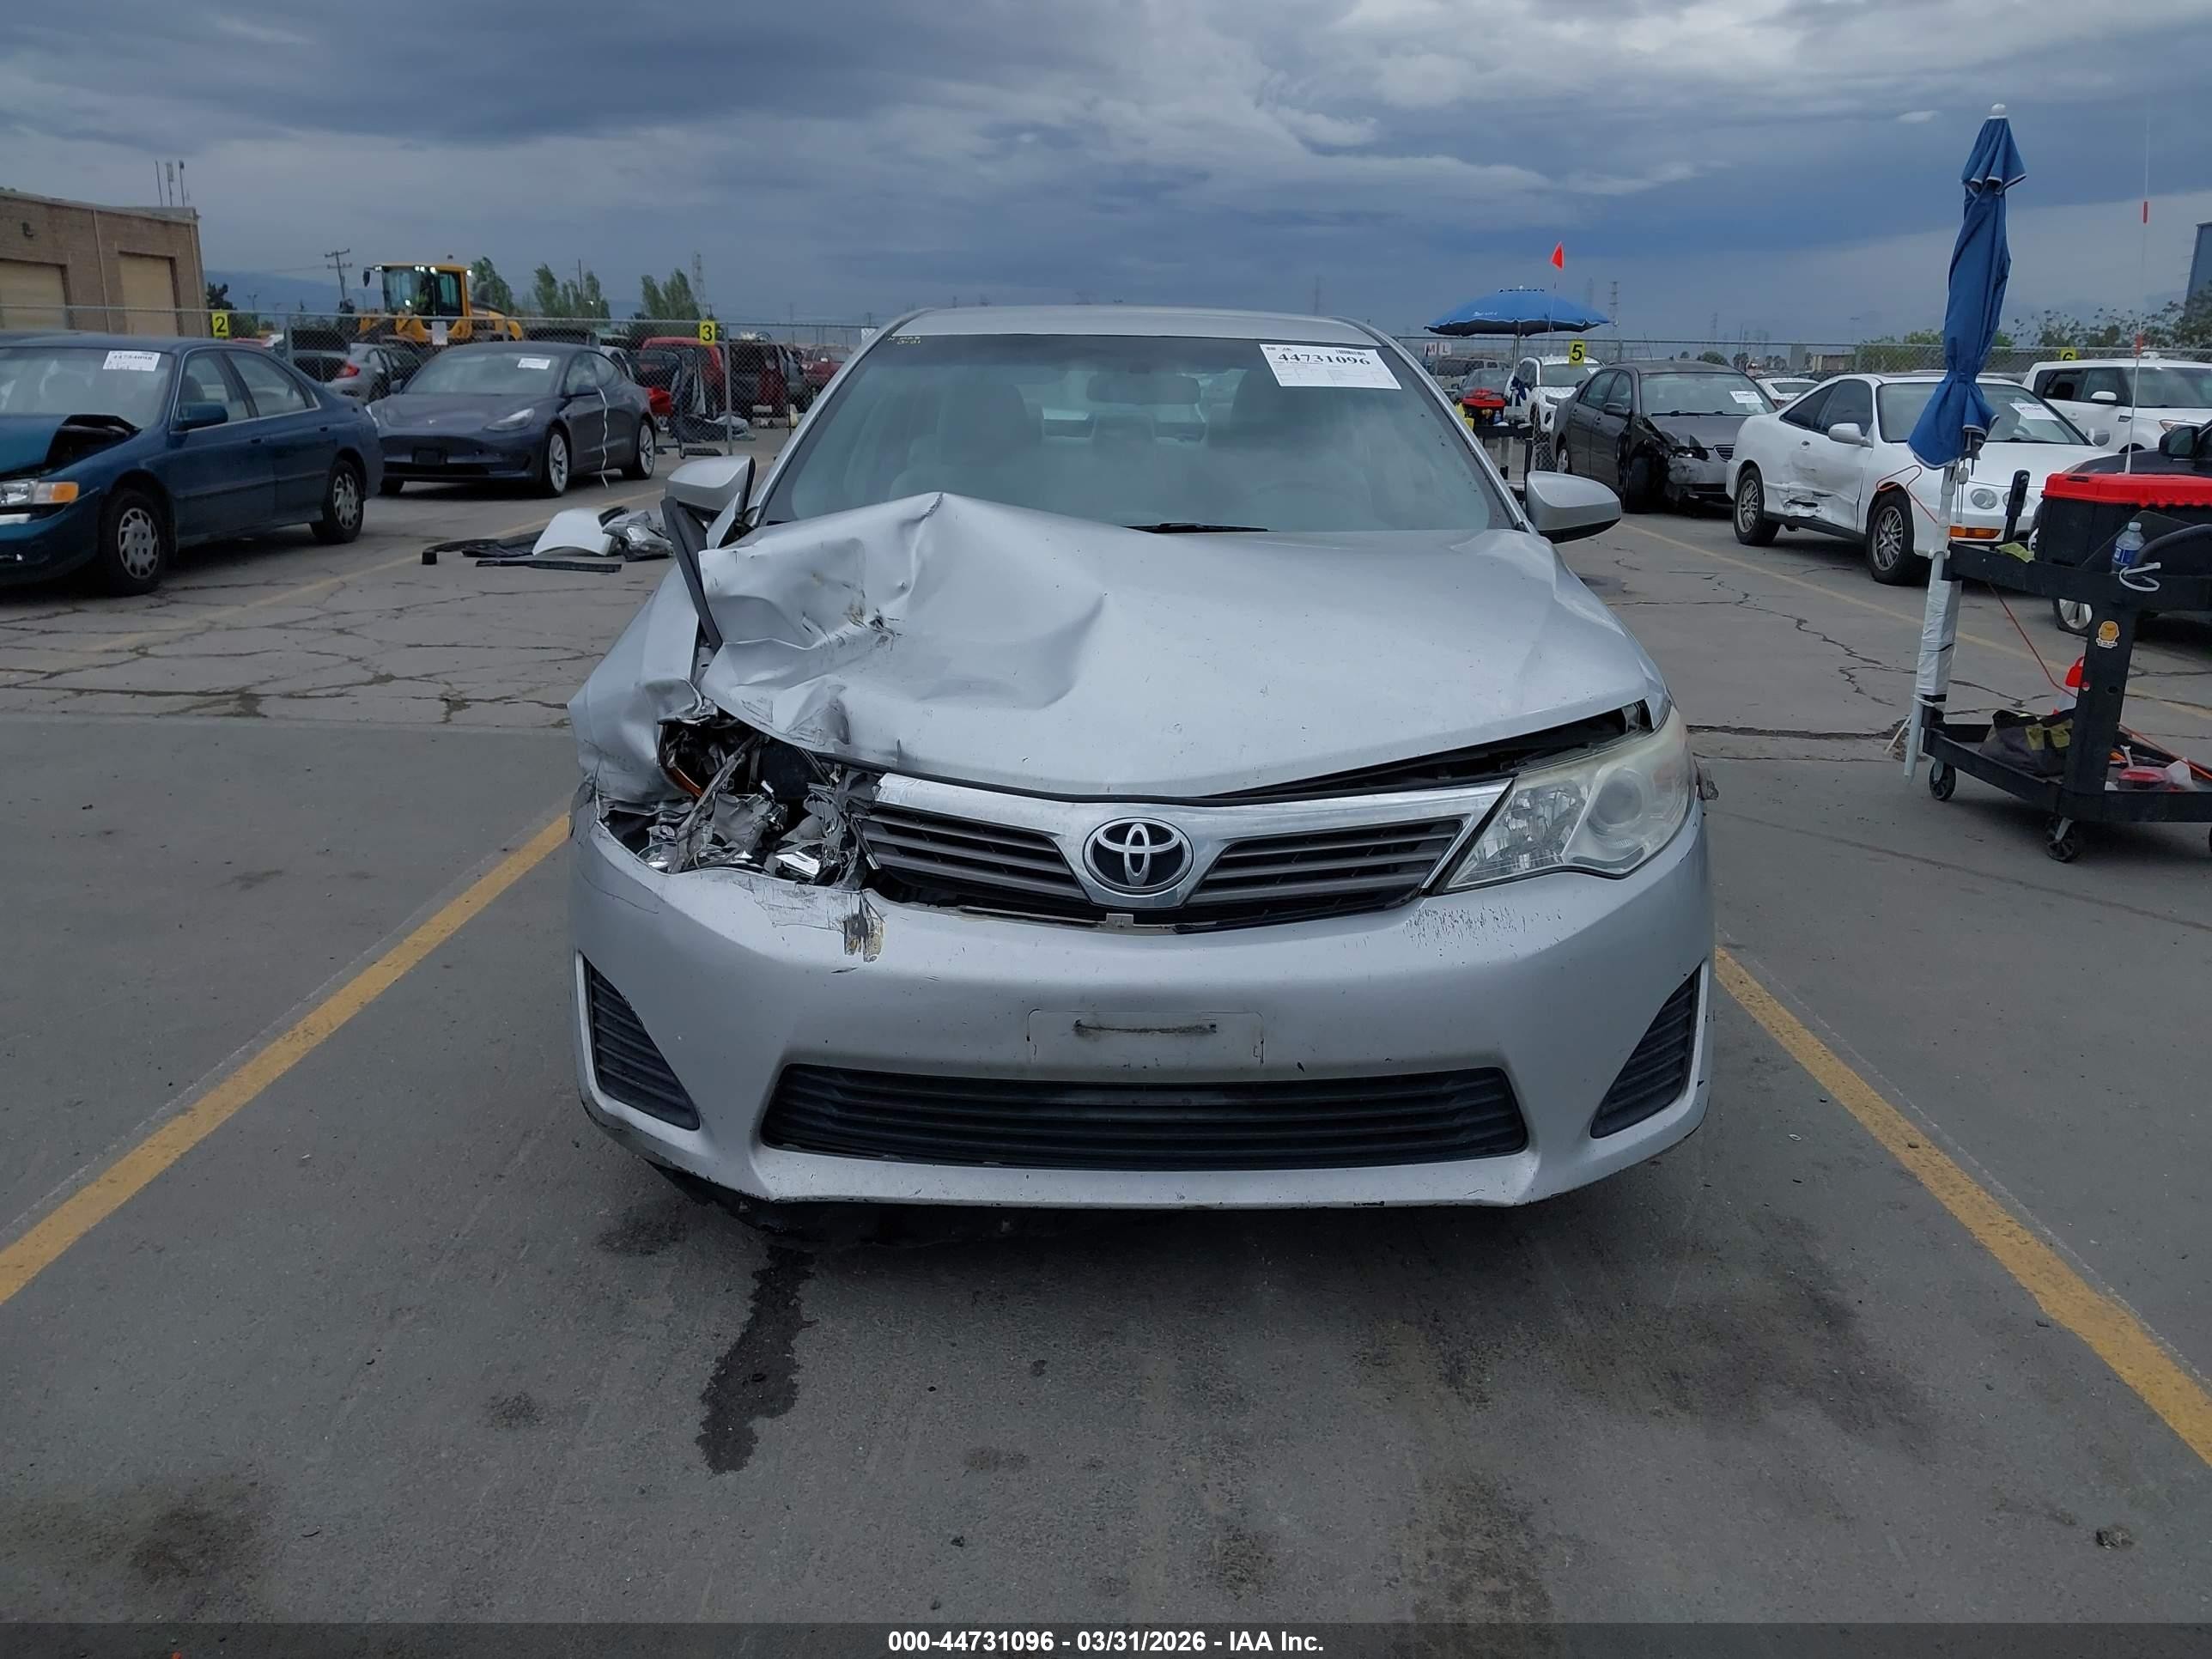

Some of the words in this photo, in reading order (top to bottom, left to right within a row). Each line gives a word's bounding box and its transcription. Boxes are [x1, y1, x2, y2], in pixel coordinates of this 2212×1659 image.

[215, 316, 227, 332] 2
[702, 325, 713, 341] 3
[1278, 353, 1371, 365] 44731096
[1571, 343, 1583, 361] 5
